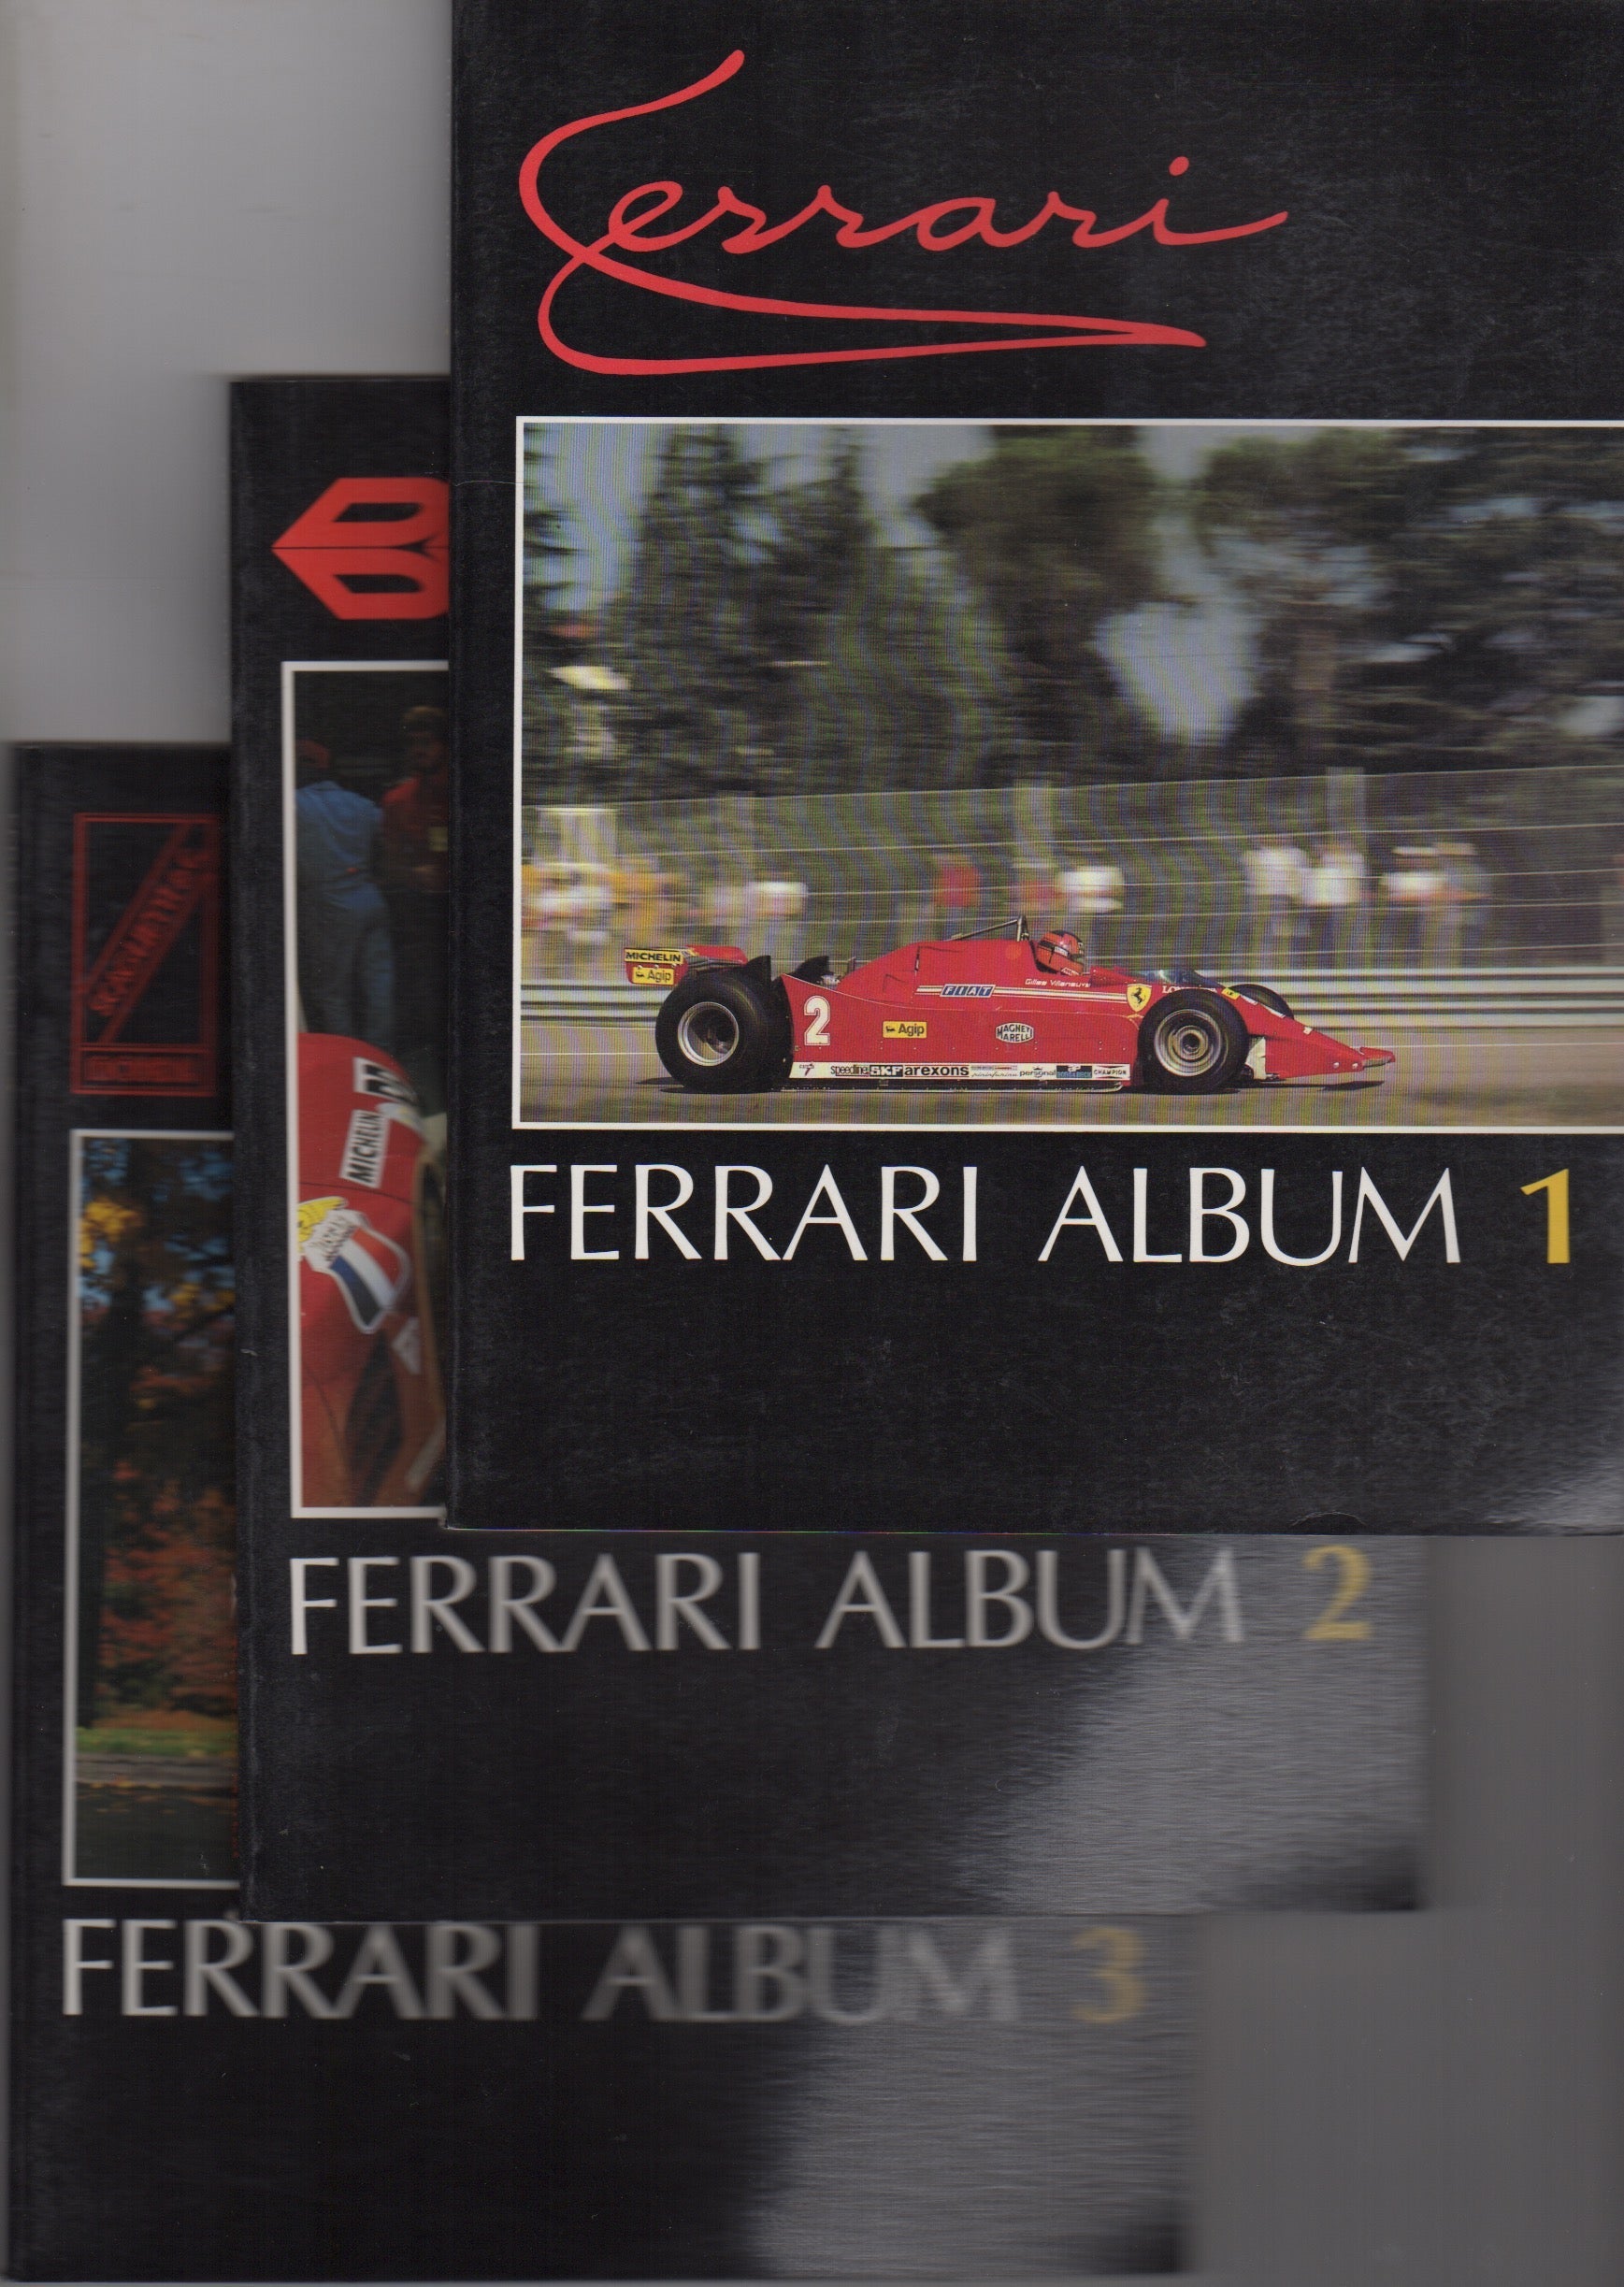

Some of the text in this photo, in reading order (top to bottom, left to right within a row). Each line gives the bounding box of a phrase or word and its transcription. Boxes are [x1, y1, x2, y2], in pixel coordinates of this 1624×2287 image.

[520, 50, 1287, 376] Ferrari
[625, 952, 681, 962] MICHELIN
[647, 969, 671, 983] Agip
[943, 985, 992, 997] FIAT
[804, 996, 831, 1045] 2
[898, 1022, 925, 1037] Agip
[869, 1065, 903, 1076] SKF
[904, 1065, 970, 1076] arexons
[347, 1110, 382, 1185] MICHELIN
[510, 1163, 1570, 1266] FERRARI ALBUM 1
[290, 1545, 1372, 1657] FERRARI ALBUM 2
[62, 1917, 1146, 2027] FERRARI ALBUM 3
